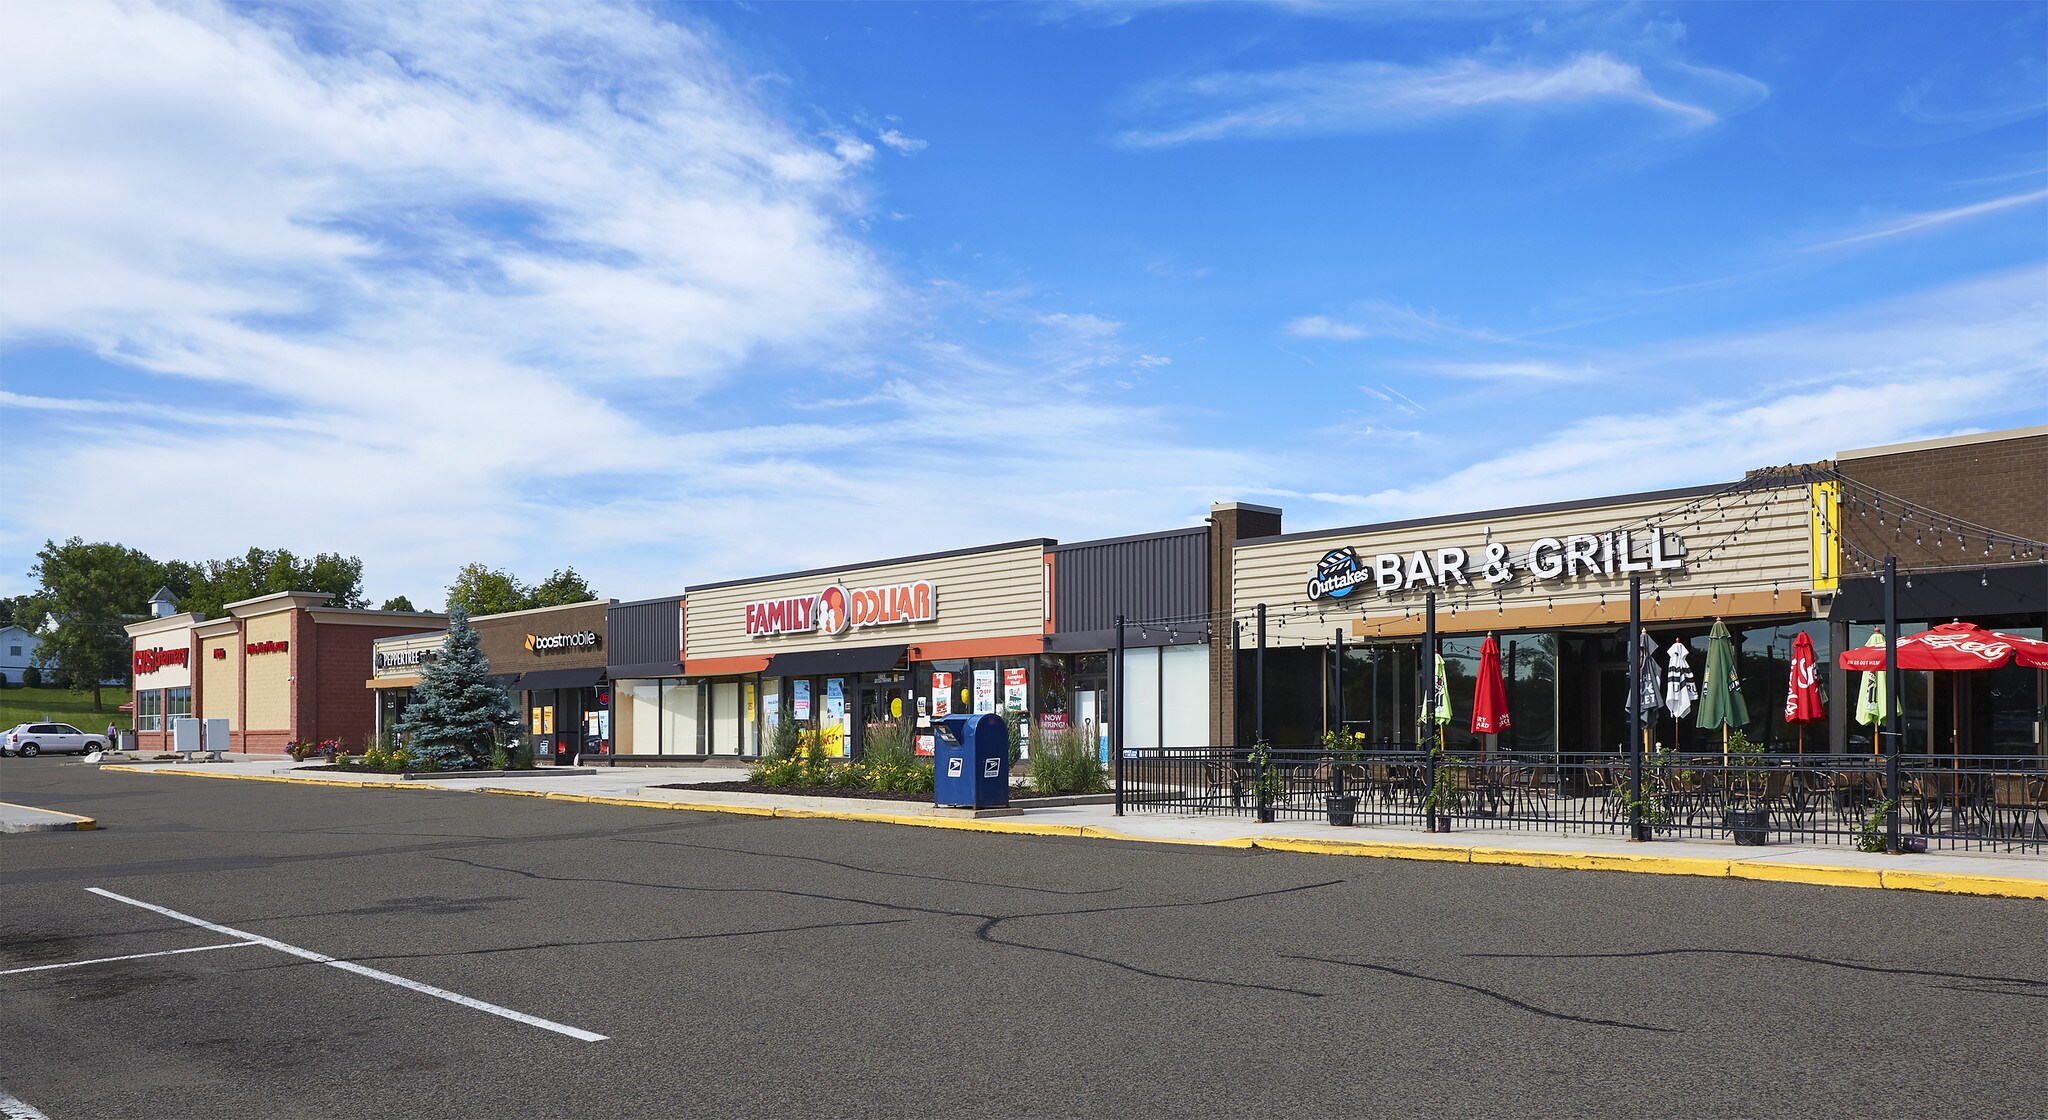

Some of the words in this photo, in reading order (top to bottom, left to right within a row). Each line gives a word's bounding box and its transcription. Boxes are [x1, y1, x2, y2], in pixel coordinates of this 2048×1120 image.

[1375, 547, 1468, 591] BAR
[1481, 542, 1513, 583] &
[1528, 526, 1683, 579] GRILL
[1308, 567, 1369, 600] Outtakes
[745, 596, 815, 635] FAMILY
[851, 582, 931, 625] DOLLAR
[383, 651, 420, 667] PEPPERTREE
